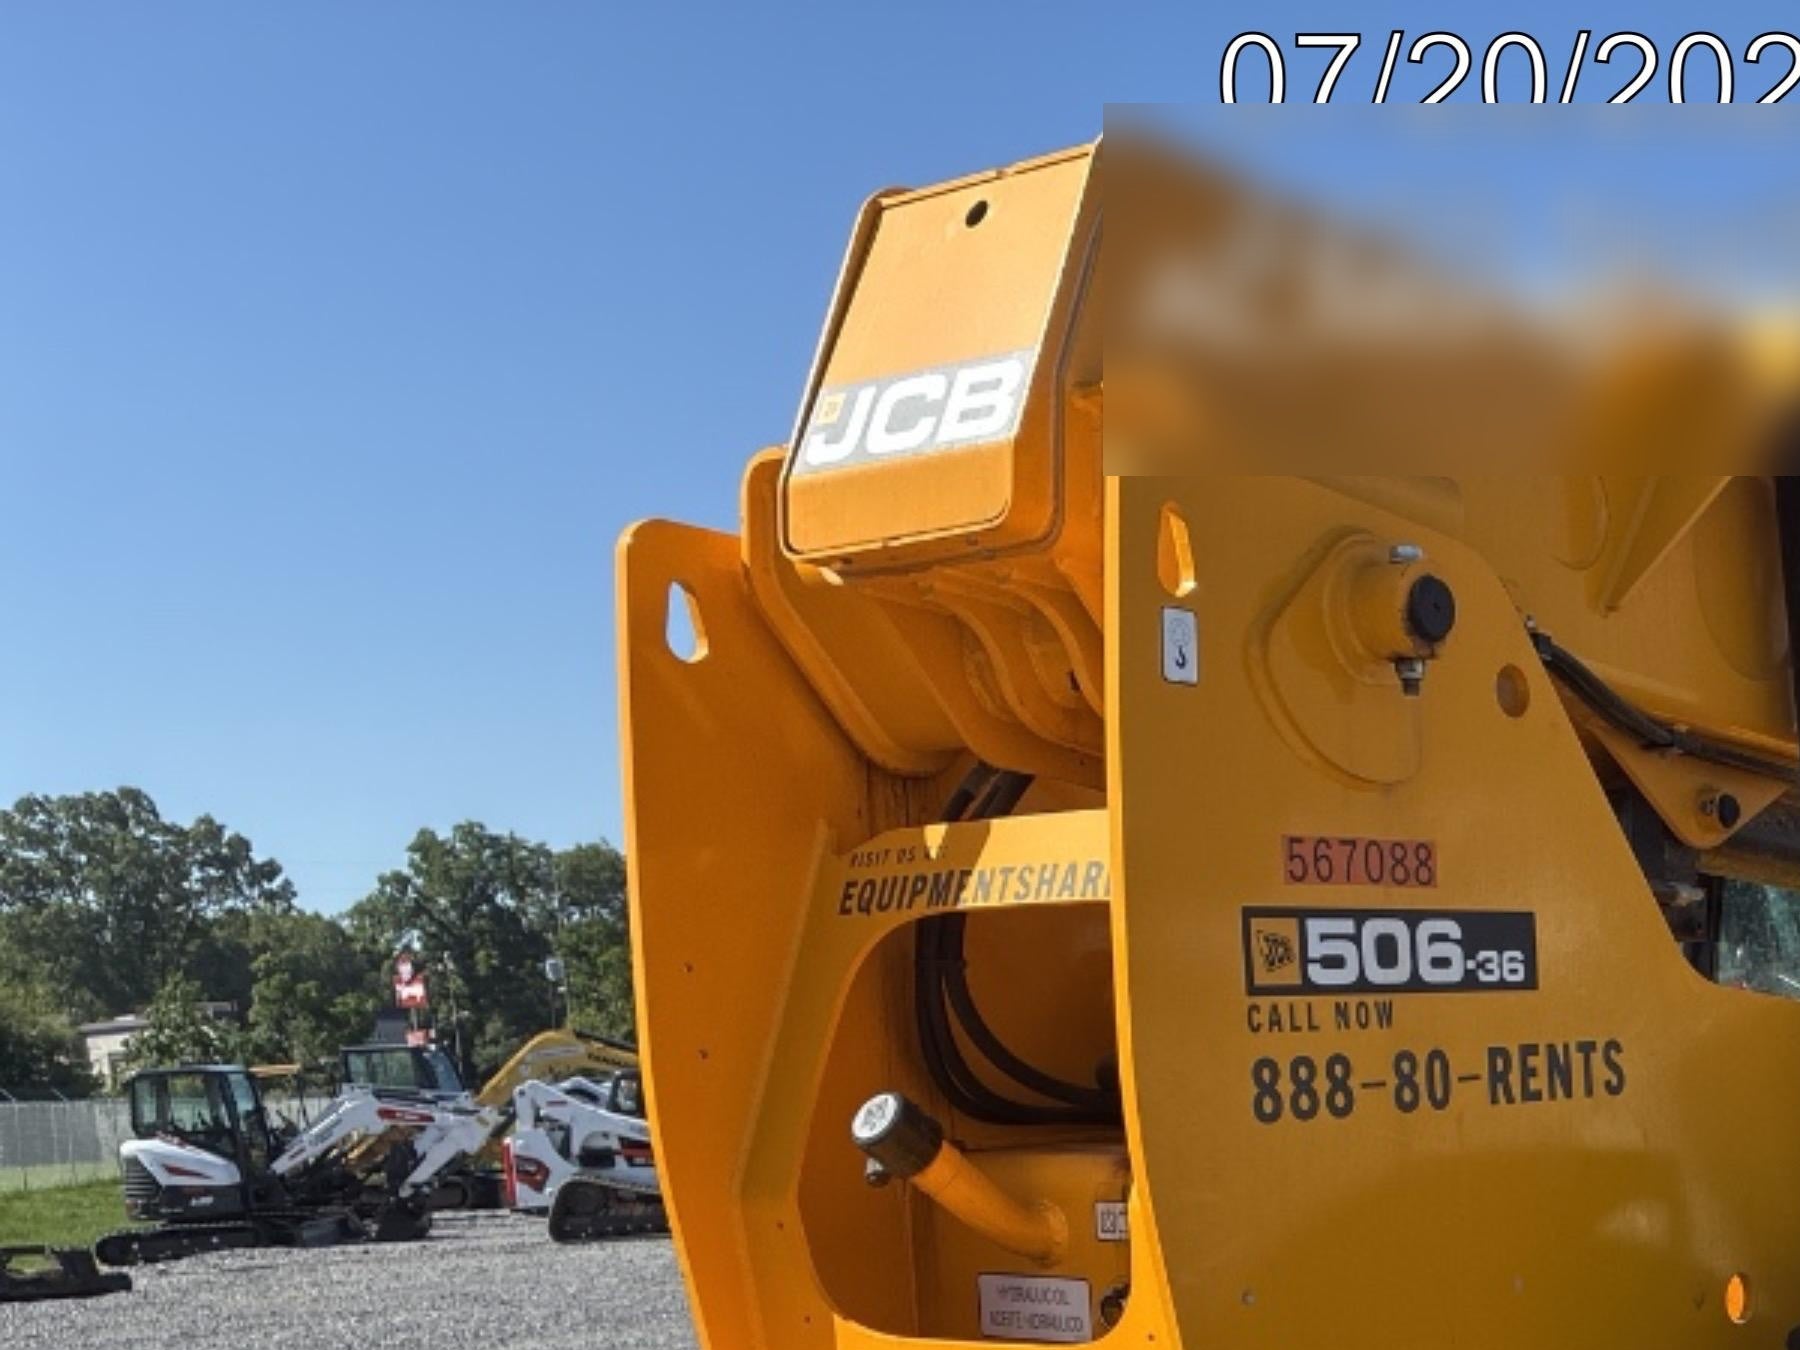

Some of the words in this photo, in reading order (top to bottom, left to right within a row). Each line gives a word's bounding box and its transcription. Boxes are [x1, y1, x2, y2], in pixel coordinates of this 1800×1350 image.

[805, 360, 1023, 465] JCB
[1287, 836, 1434, 886] 567088
[1305, 917, 1525, 985] 506-36
[1247, 1003, 1320, 1033] CALL
[1334, 1001, 1394, 1031] NOW
[1251, 1038, 1627, 1125] 888-80-RENTS
